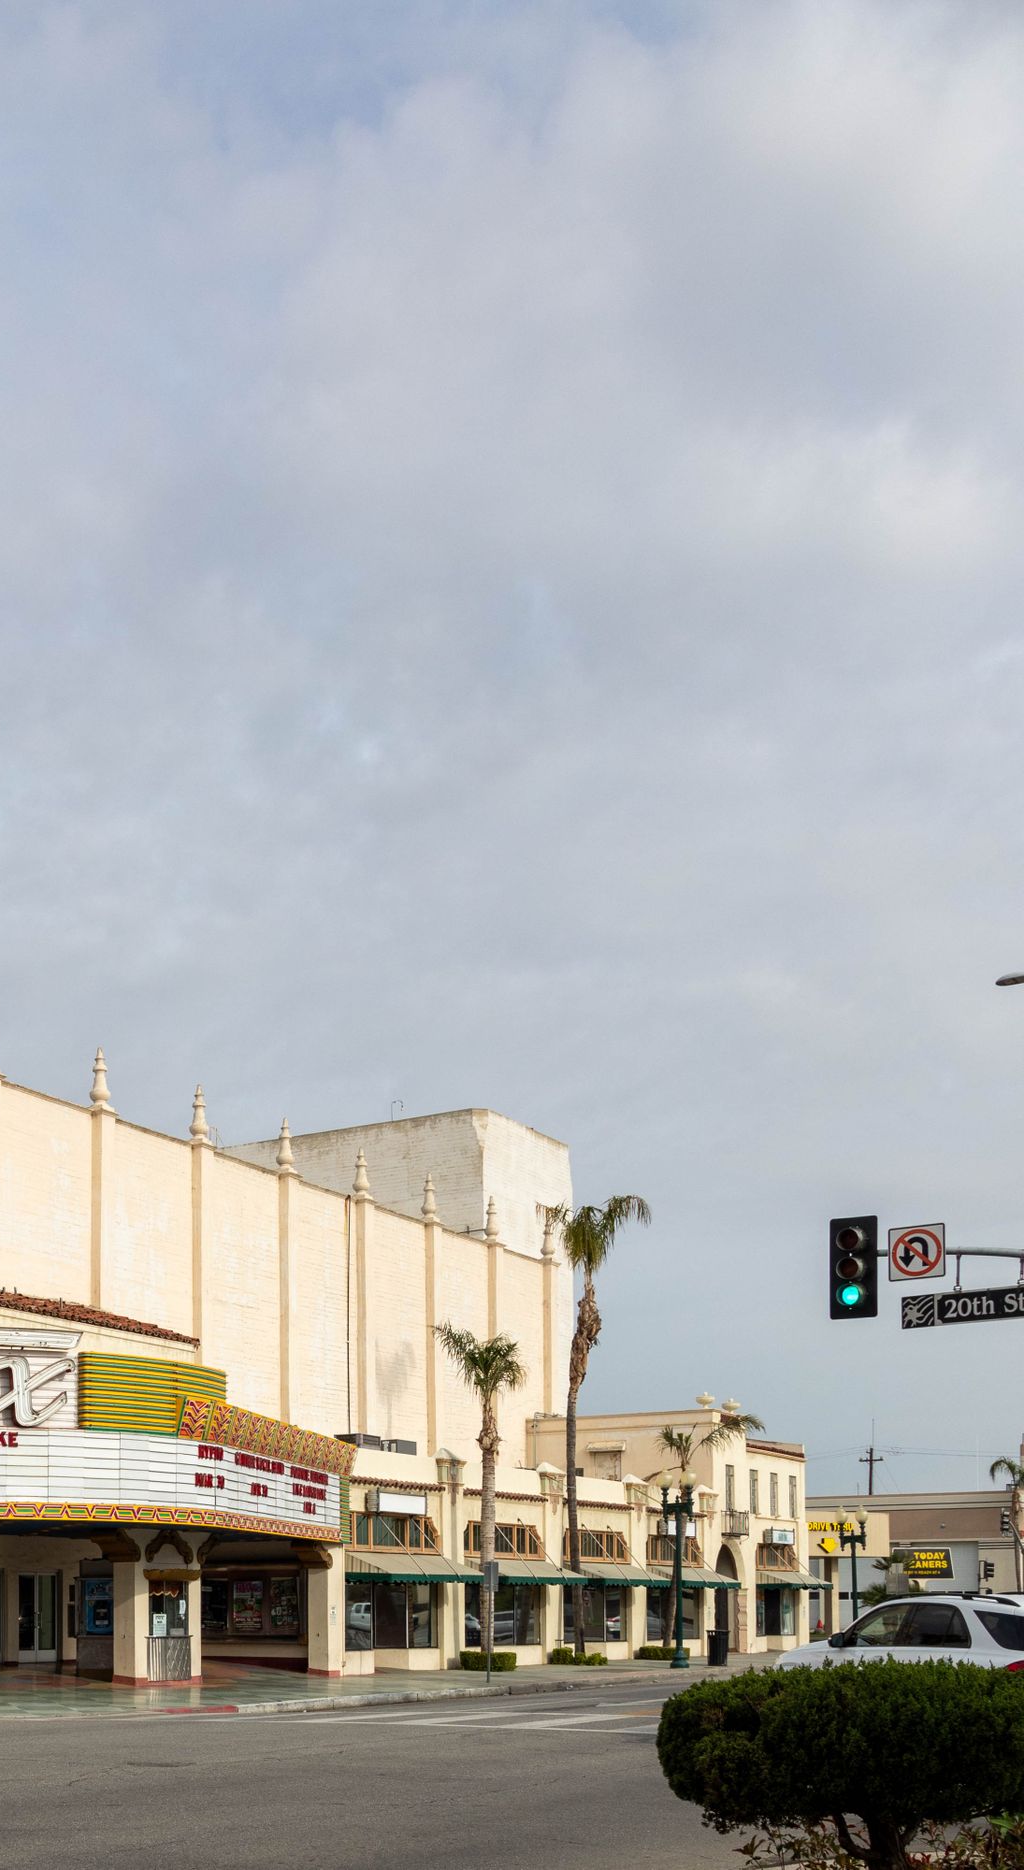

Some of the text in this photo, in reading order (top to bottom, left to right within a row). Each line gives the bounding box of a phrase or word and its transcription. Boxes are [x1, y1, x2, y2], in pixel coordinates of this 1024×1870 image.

[943, 1292, 1024, 1319] 20th St
[195, 1472, 213, 1488] MAR
[808, 1522, 830, 1532] DRIVE
[913, 1552, 945, 1560] TODAY
